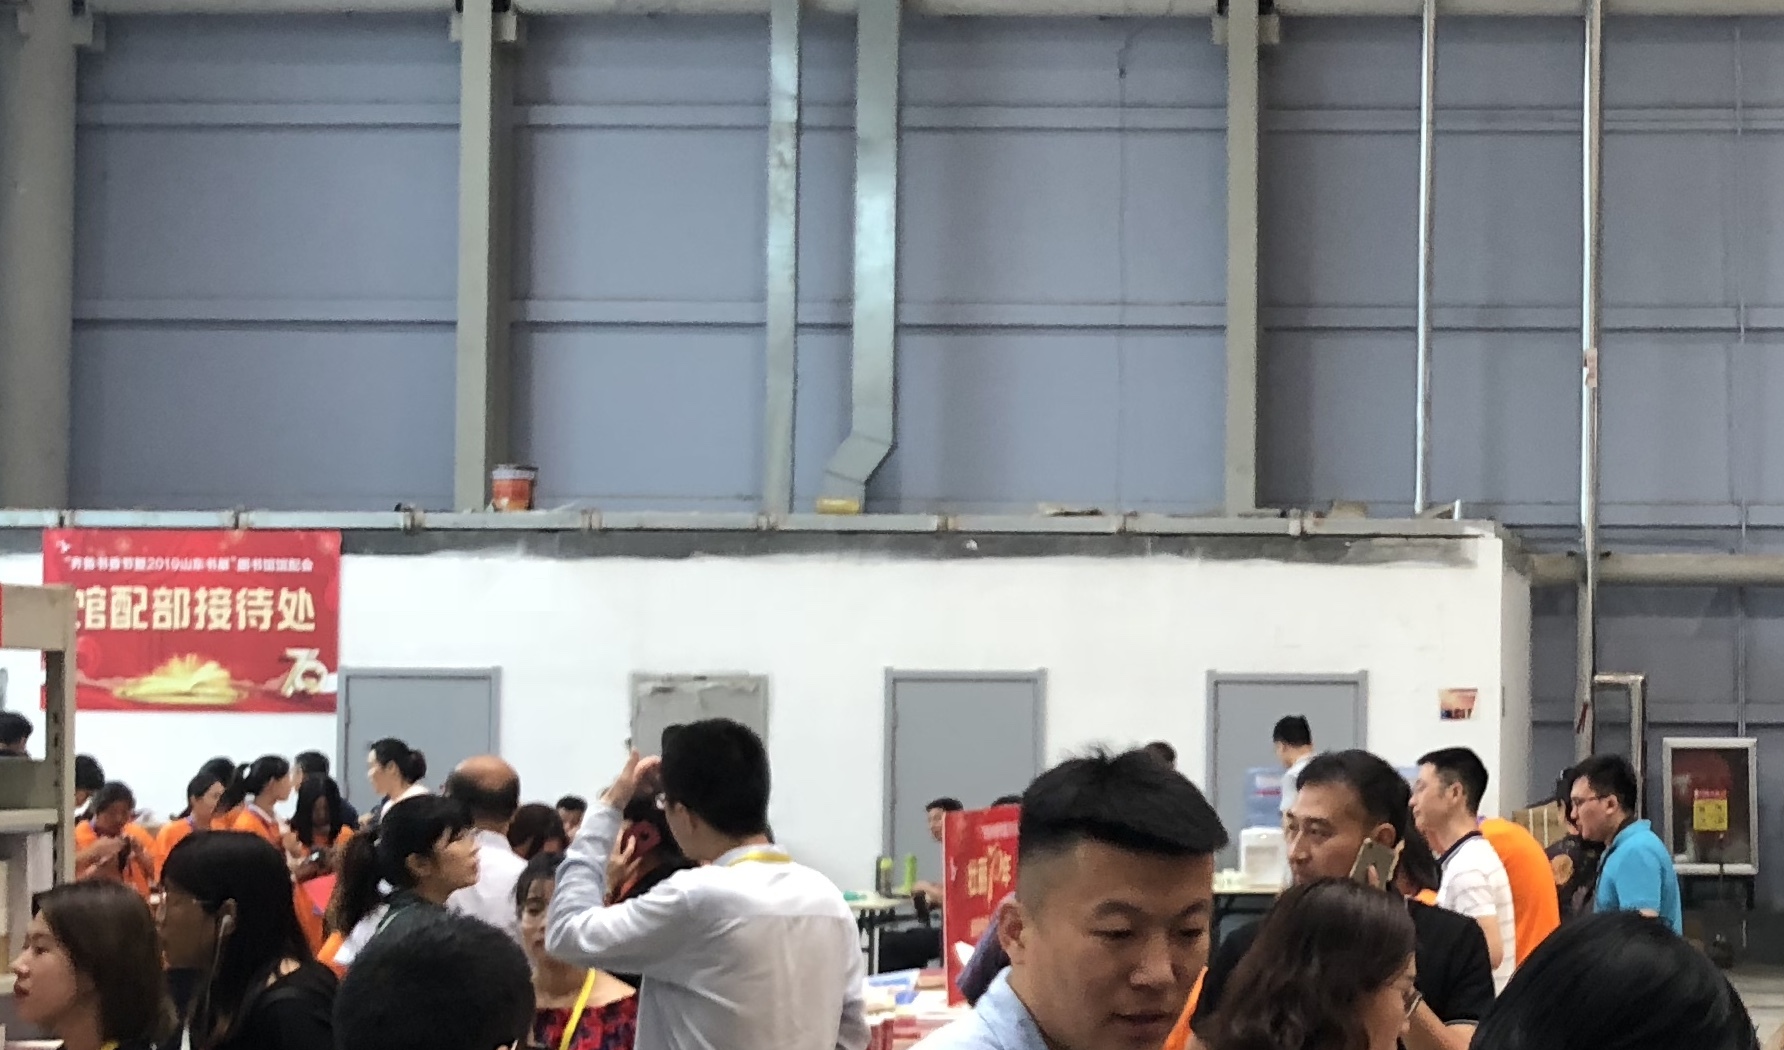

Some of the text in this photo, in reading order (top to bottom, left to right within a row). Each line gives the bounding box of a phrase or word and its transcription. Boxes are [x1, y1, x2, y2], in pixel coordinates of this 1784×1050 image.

[75, 584, 316, 632] 馆配部接待处
